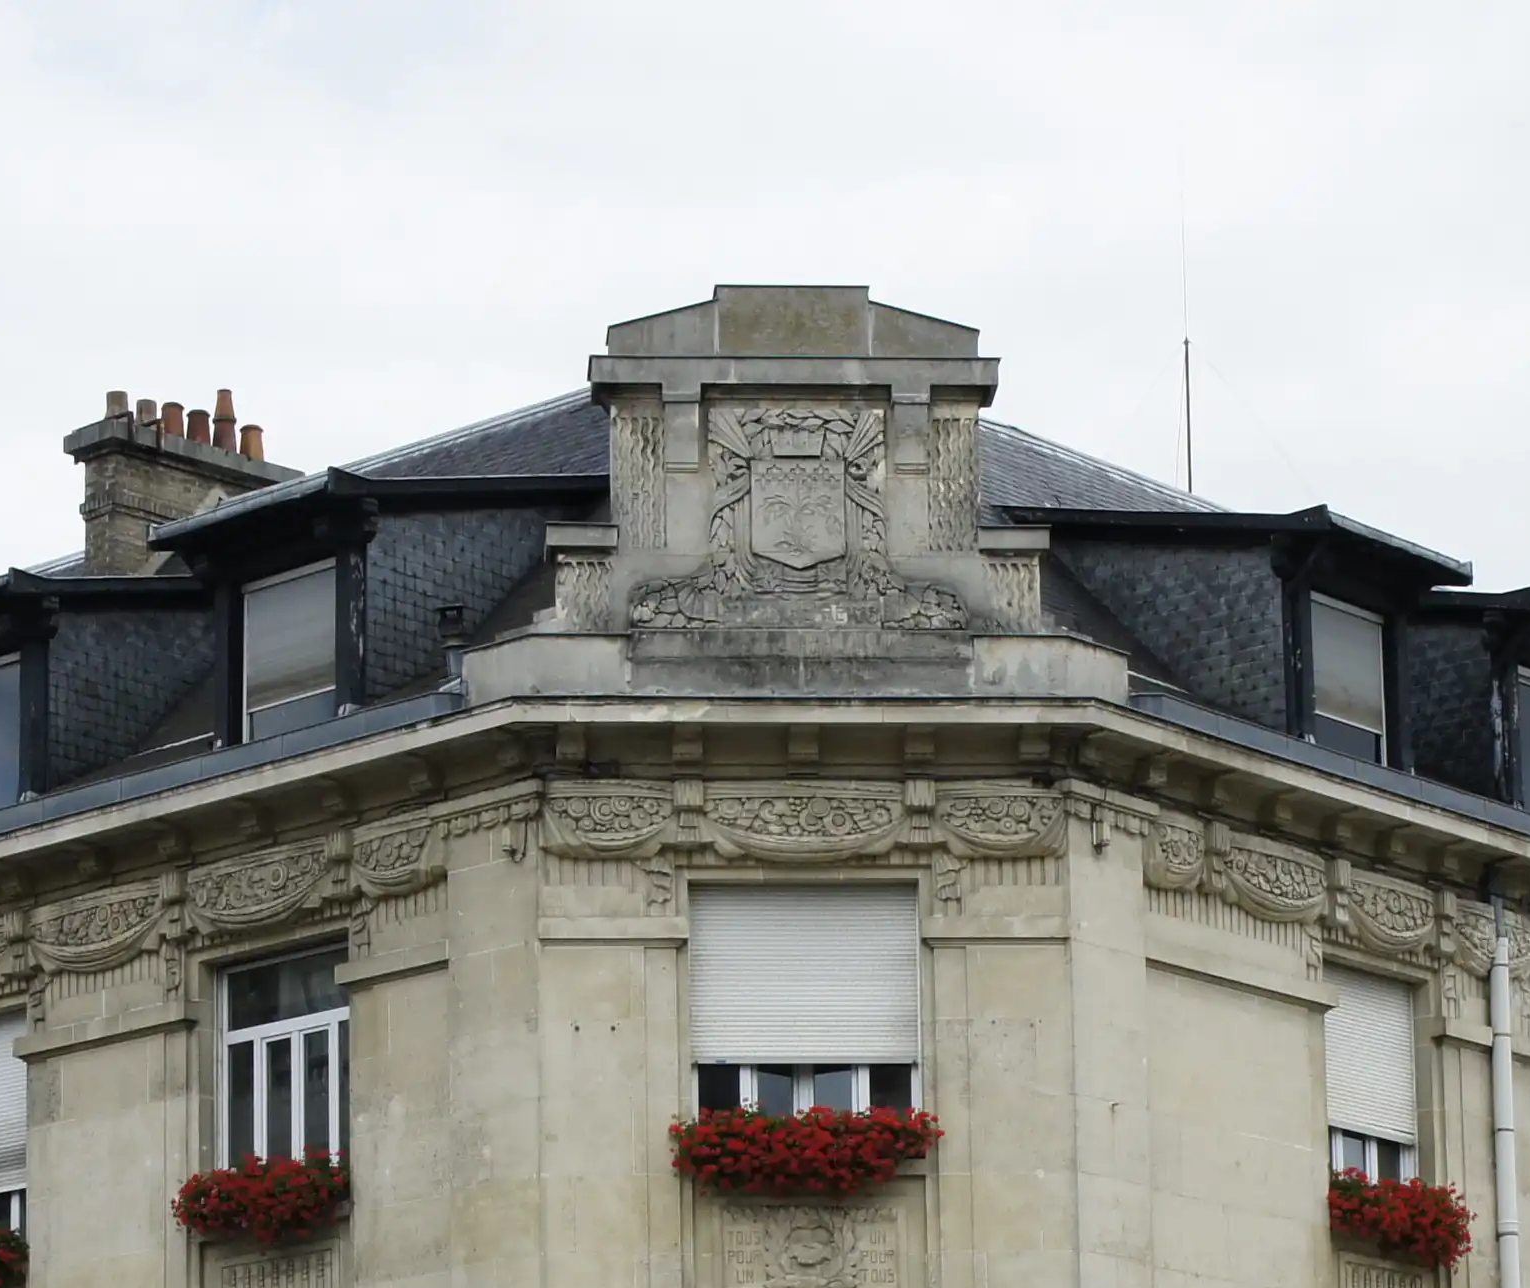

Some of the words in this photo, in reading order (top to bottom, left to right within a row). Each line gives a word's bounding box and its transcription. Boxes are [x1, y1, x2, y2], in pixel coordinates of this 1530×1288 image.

[727, 1230, 761, 1246] TOUS
[870, 1229, 886, 1244] UN
[727, 1250, 759, 1265] POUR
[862, 1250, 894, 1264] POUR
[736, 1269, 754, 1284] UN
[859, 1269, 895, 1283] TOUS
